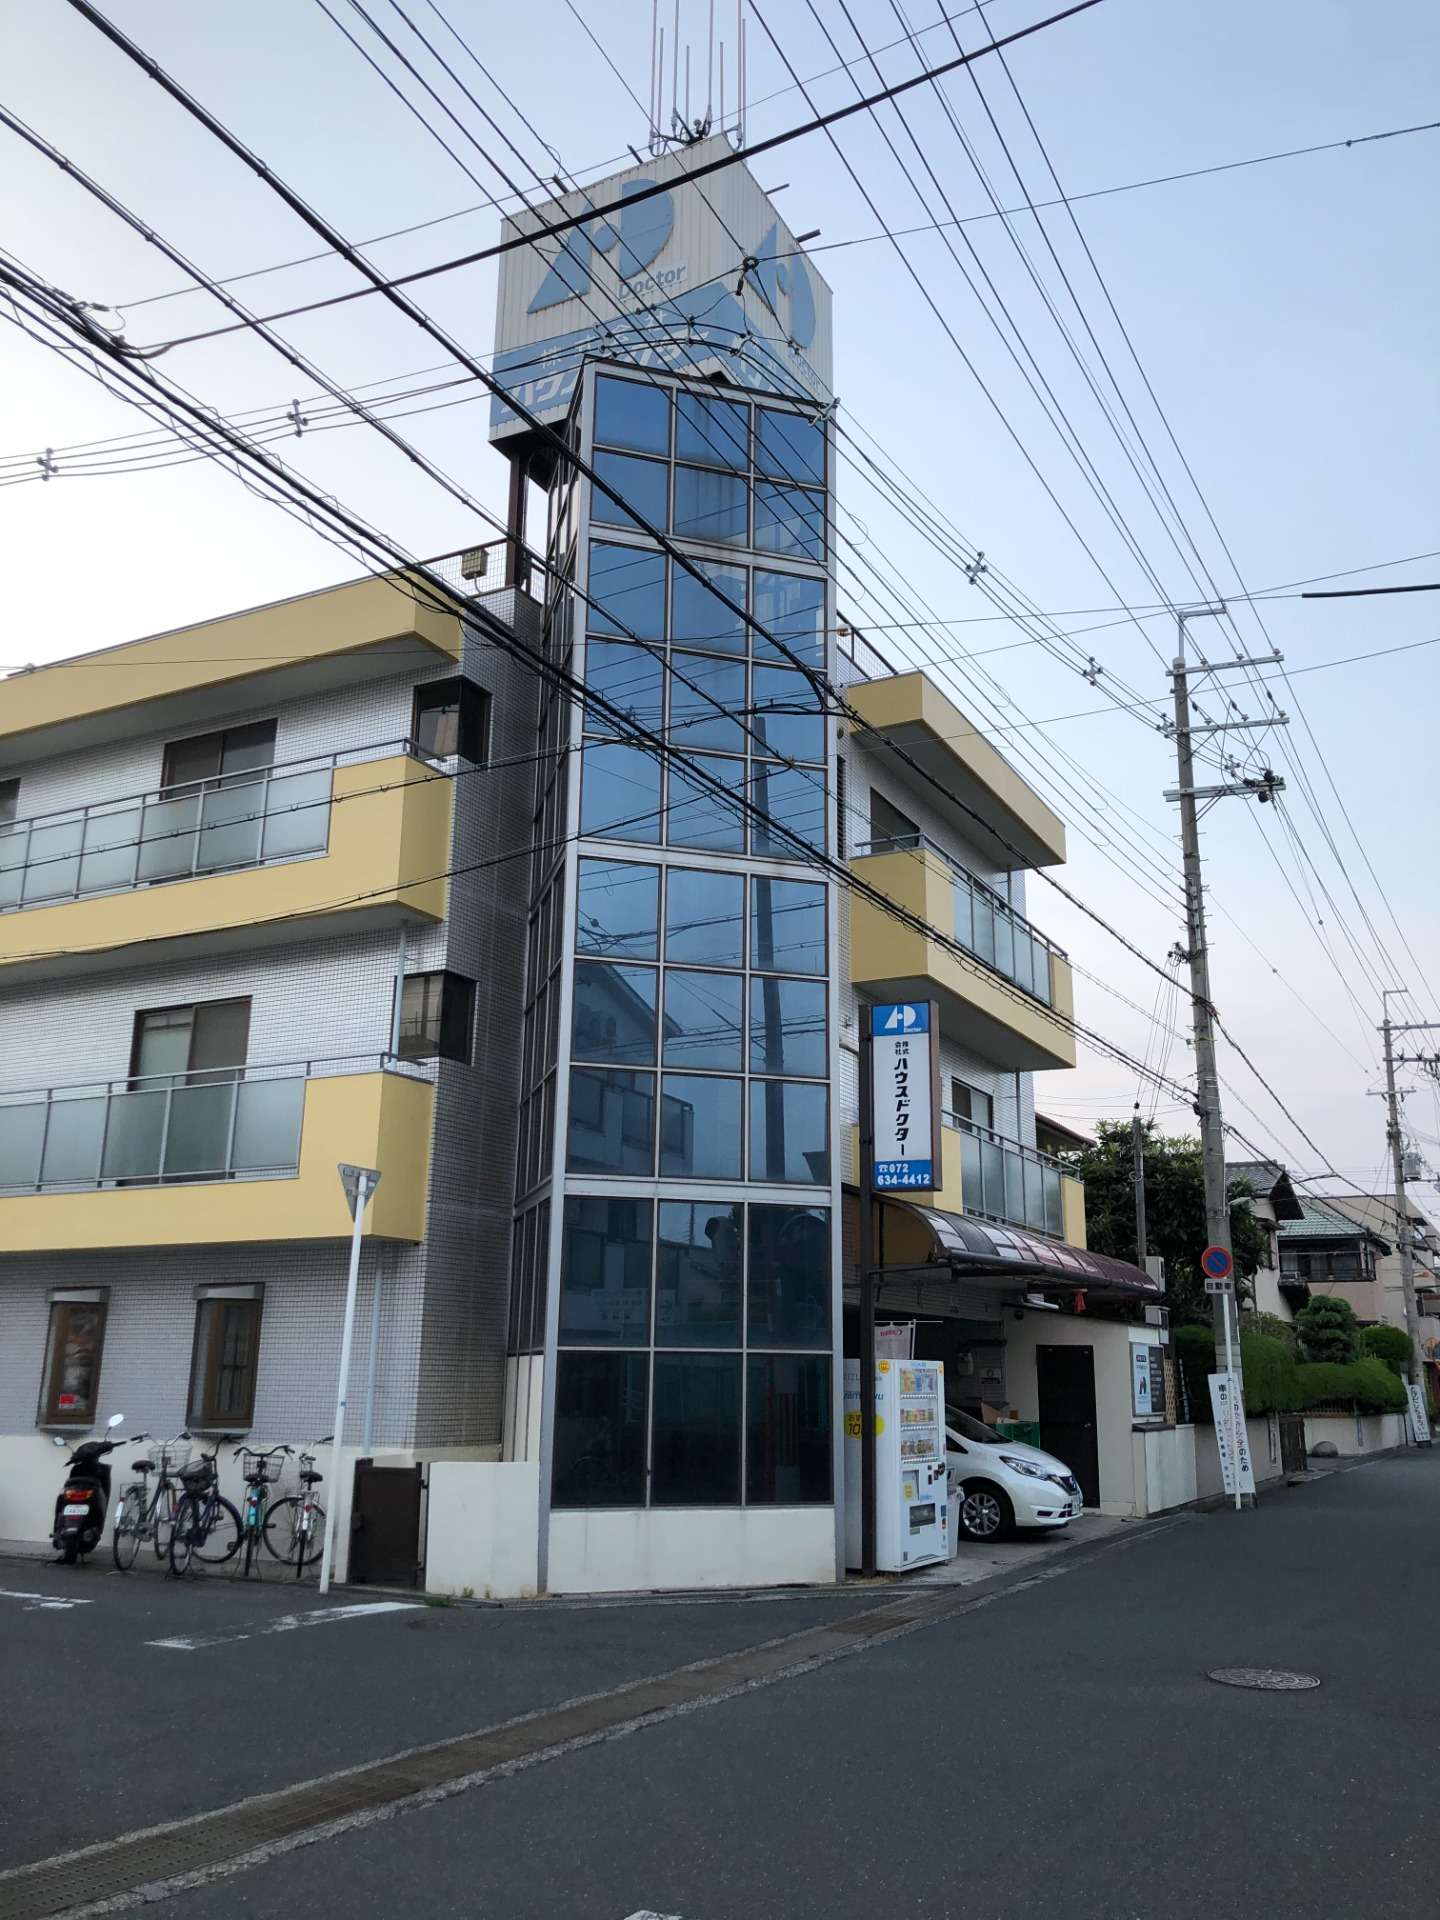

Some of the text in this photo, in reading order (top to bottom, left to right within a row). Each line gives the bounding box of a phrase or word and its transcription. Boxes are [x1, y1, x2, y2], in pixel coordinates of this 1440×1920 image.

[618, 265, 687, 299] Doctor
[894, 1058, 910, 1156] ハウスドクター
[889, 1163, 909, 1174] 072
[877, 1173, 930, 1185] 634-4412
[1206, 1282, 1232, 1290] 自動車
